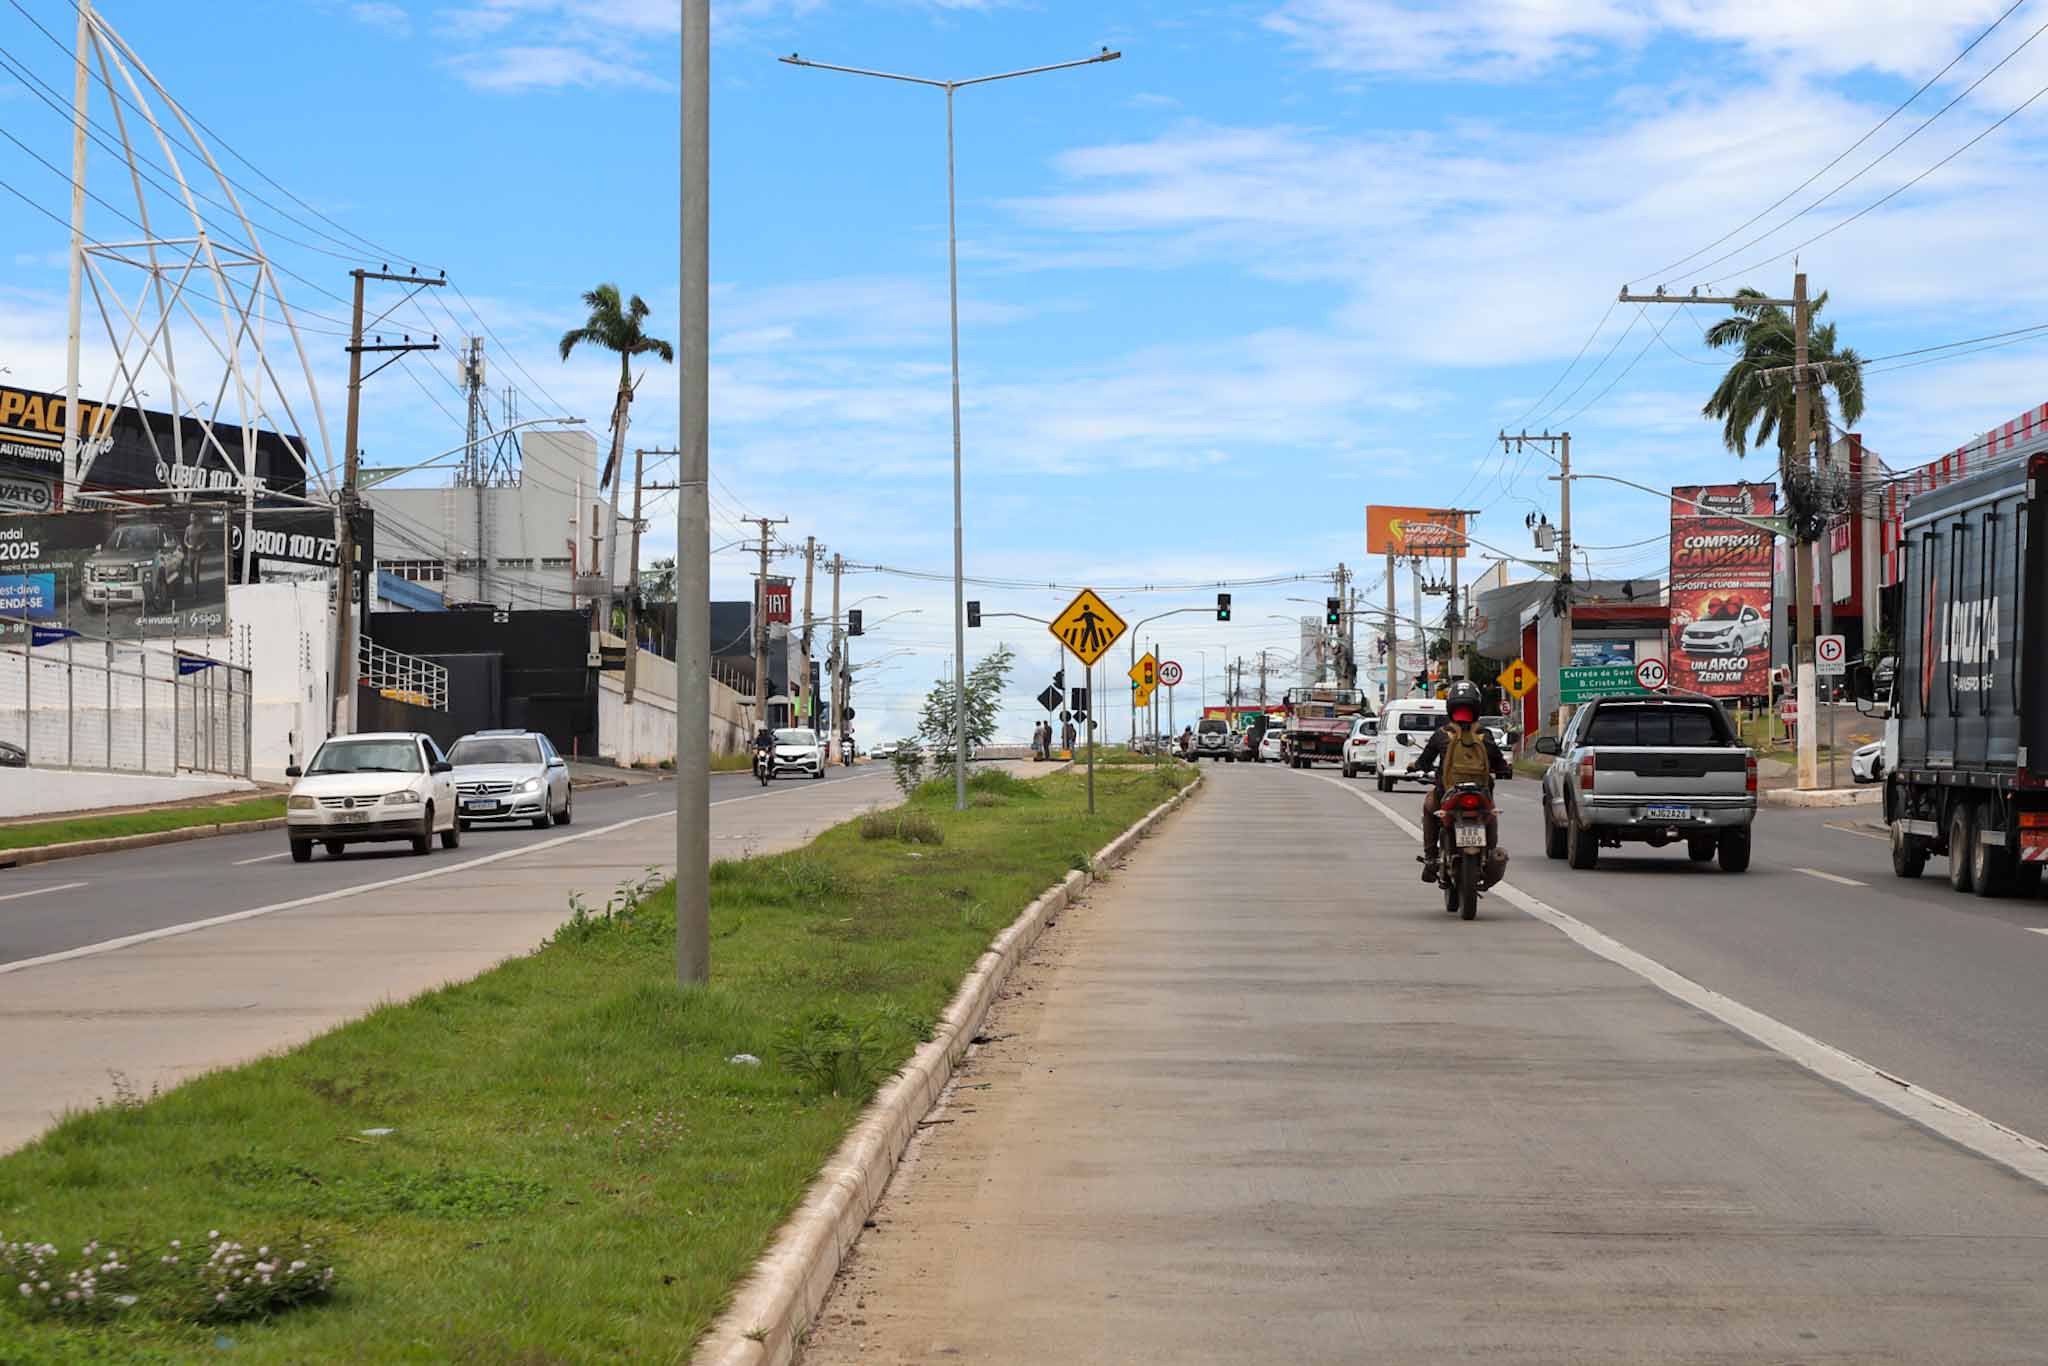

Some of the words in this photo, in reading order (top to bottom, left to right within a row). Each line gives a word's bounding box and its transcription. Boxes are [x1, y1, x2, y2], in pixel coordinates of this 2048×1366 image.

[0, 390, 114, 440] PACTO
[0, 541, 40, 560] 2025
[288, 533, 316, 561] 100
[766, 594, 788, 613] IAT
[1709, 658, 1748, 670] ARGO
[1162, 667, 1178, 678] 40
[1640, 666, 1663, 679] 40
[1726, 671, 1741, 681] KM
